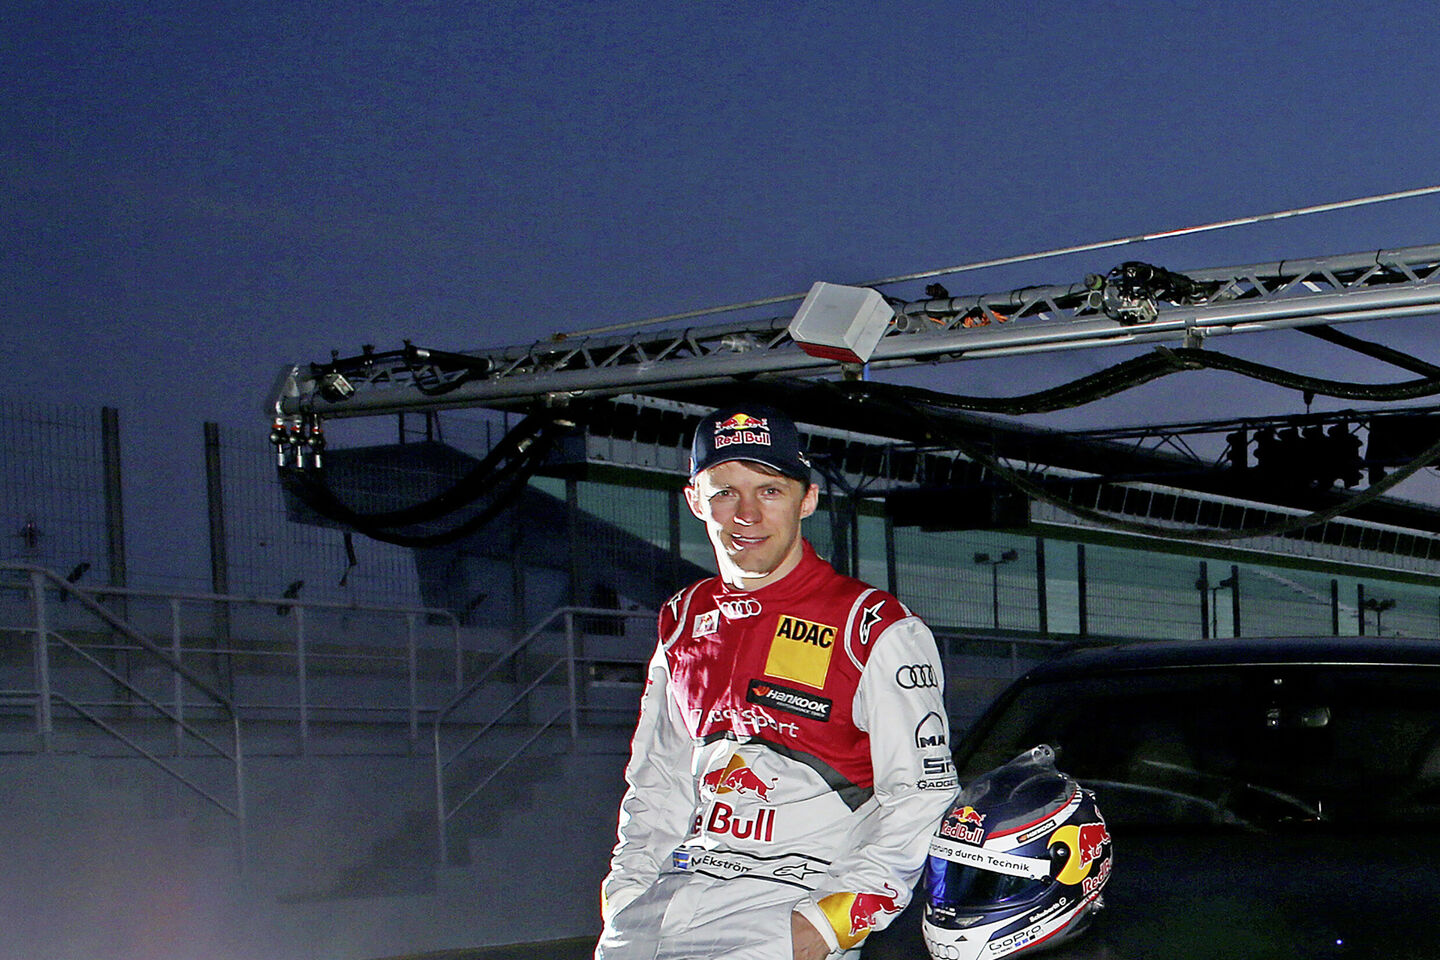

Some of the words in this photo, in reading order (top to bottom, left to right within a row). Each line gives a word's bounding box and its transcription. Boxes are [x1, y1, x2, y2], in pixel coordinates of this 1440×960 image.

[715, 432, 741, 449] Red
[743, 431, 771, 446] Bull
[776, 617, 835, 649] ADAC
[706, 801, 776, 842] Bull
[957, 825, 983, 844] Bull
[955, 849, 984, 863] durch
[987, 855, 1030, 872] Technik
[988, 924, 1042, 951] GoPro
